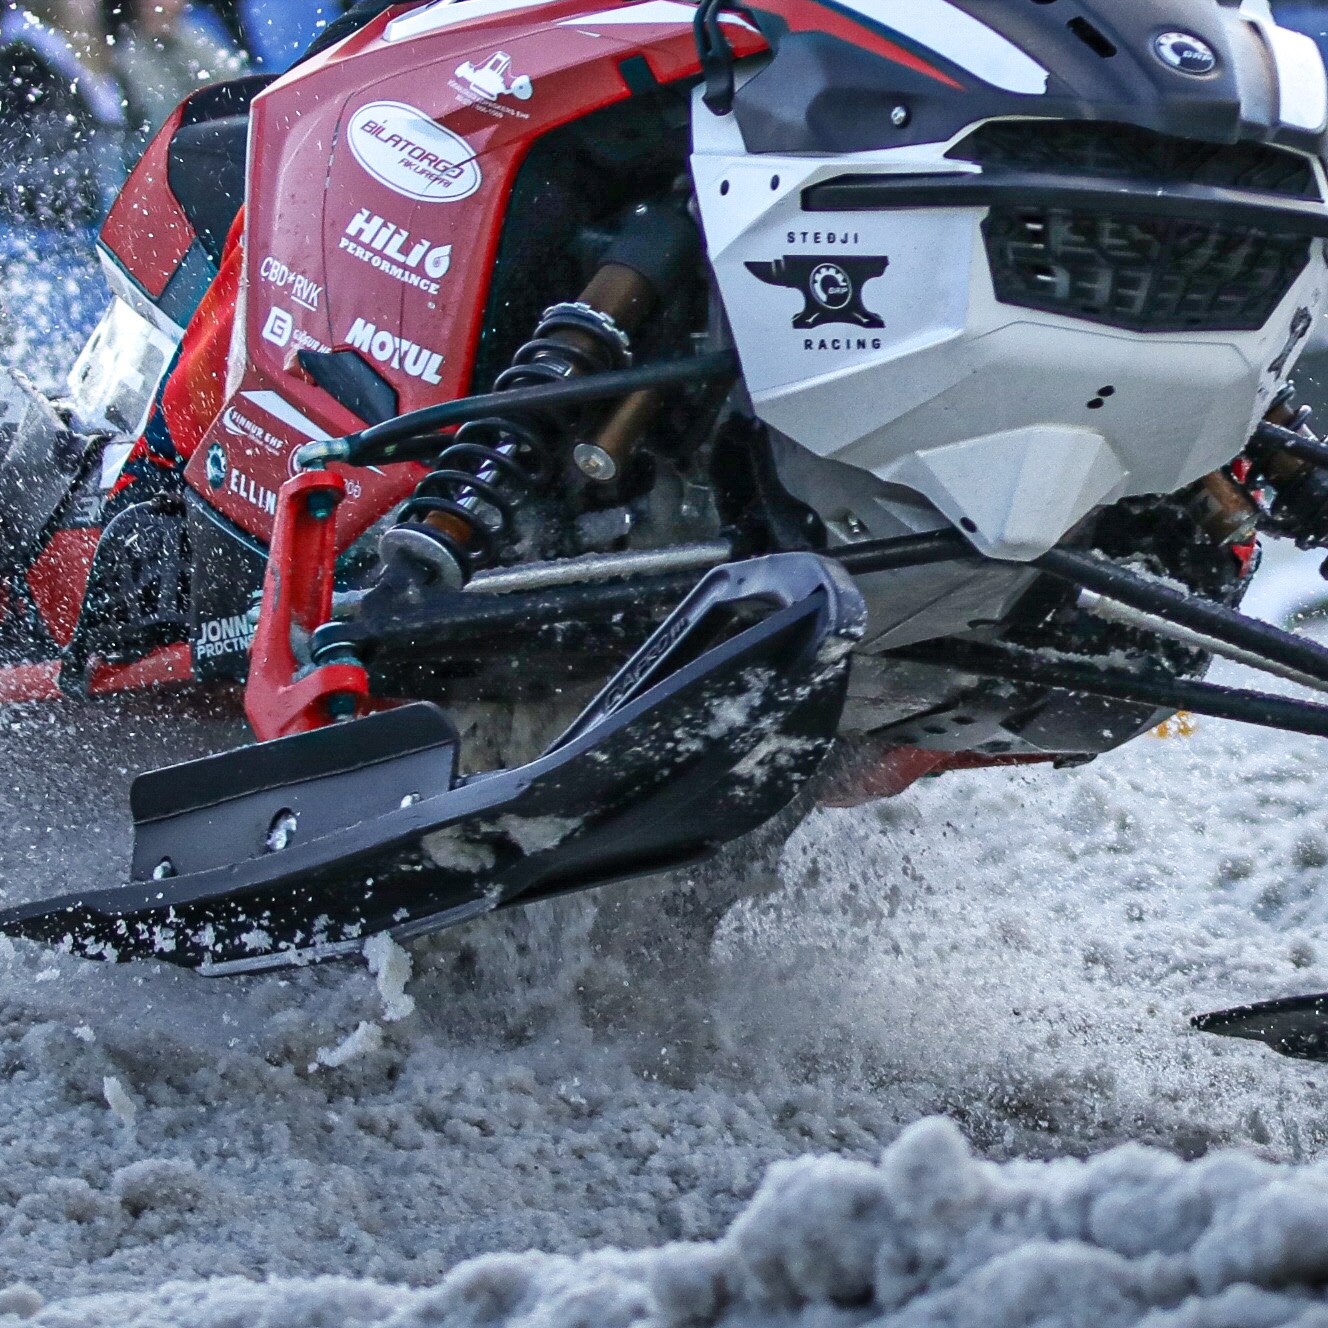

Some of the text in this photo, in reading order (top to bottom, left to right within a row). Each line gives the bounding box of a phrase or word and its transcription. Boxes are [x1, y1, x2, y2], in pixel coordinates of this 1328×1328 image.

[338, 236, 440, 295] PERFORMANCE
[344, 317, 445, 385] MOTUL
[803, 338, 881, 350] RACING
